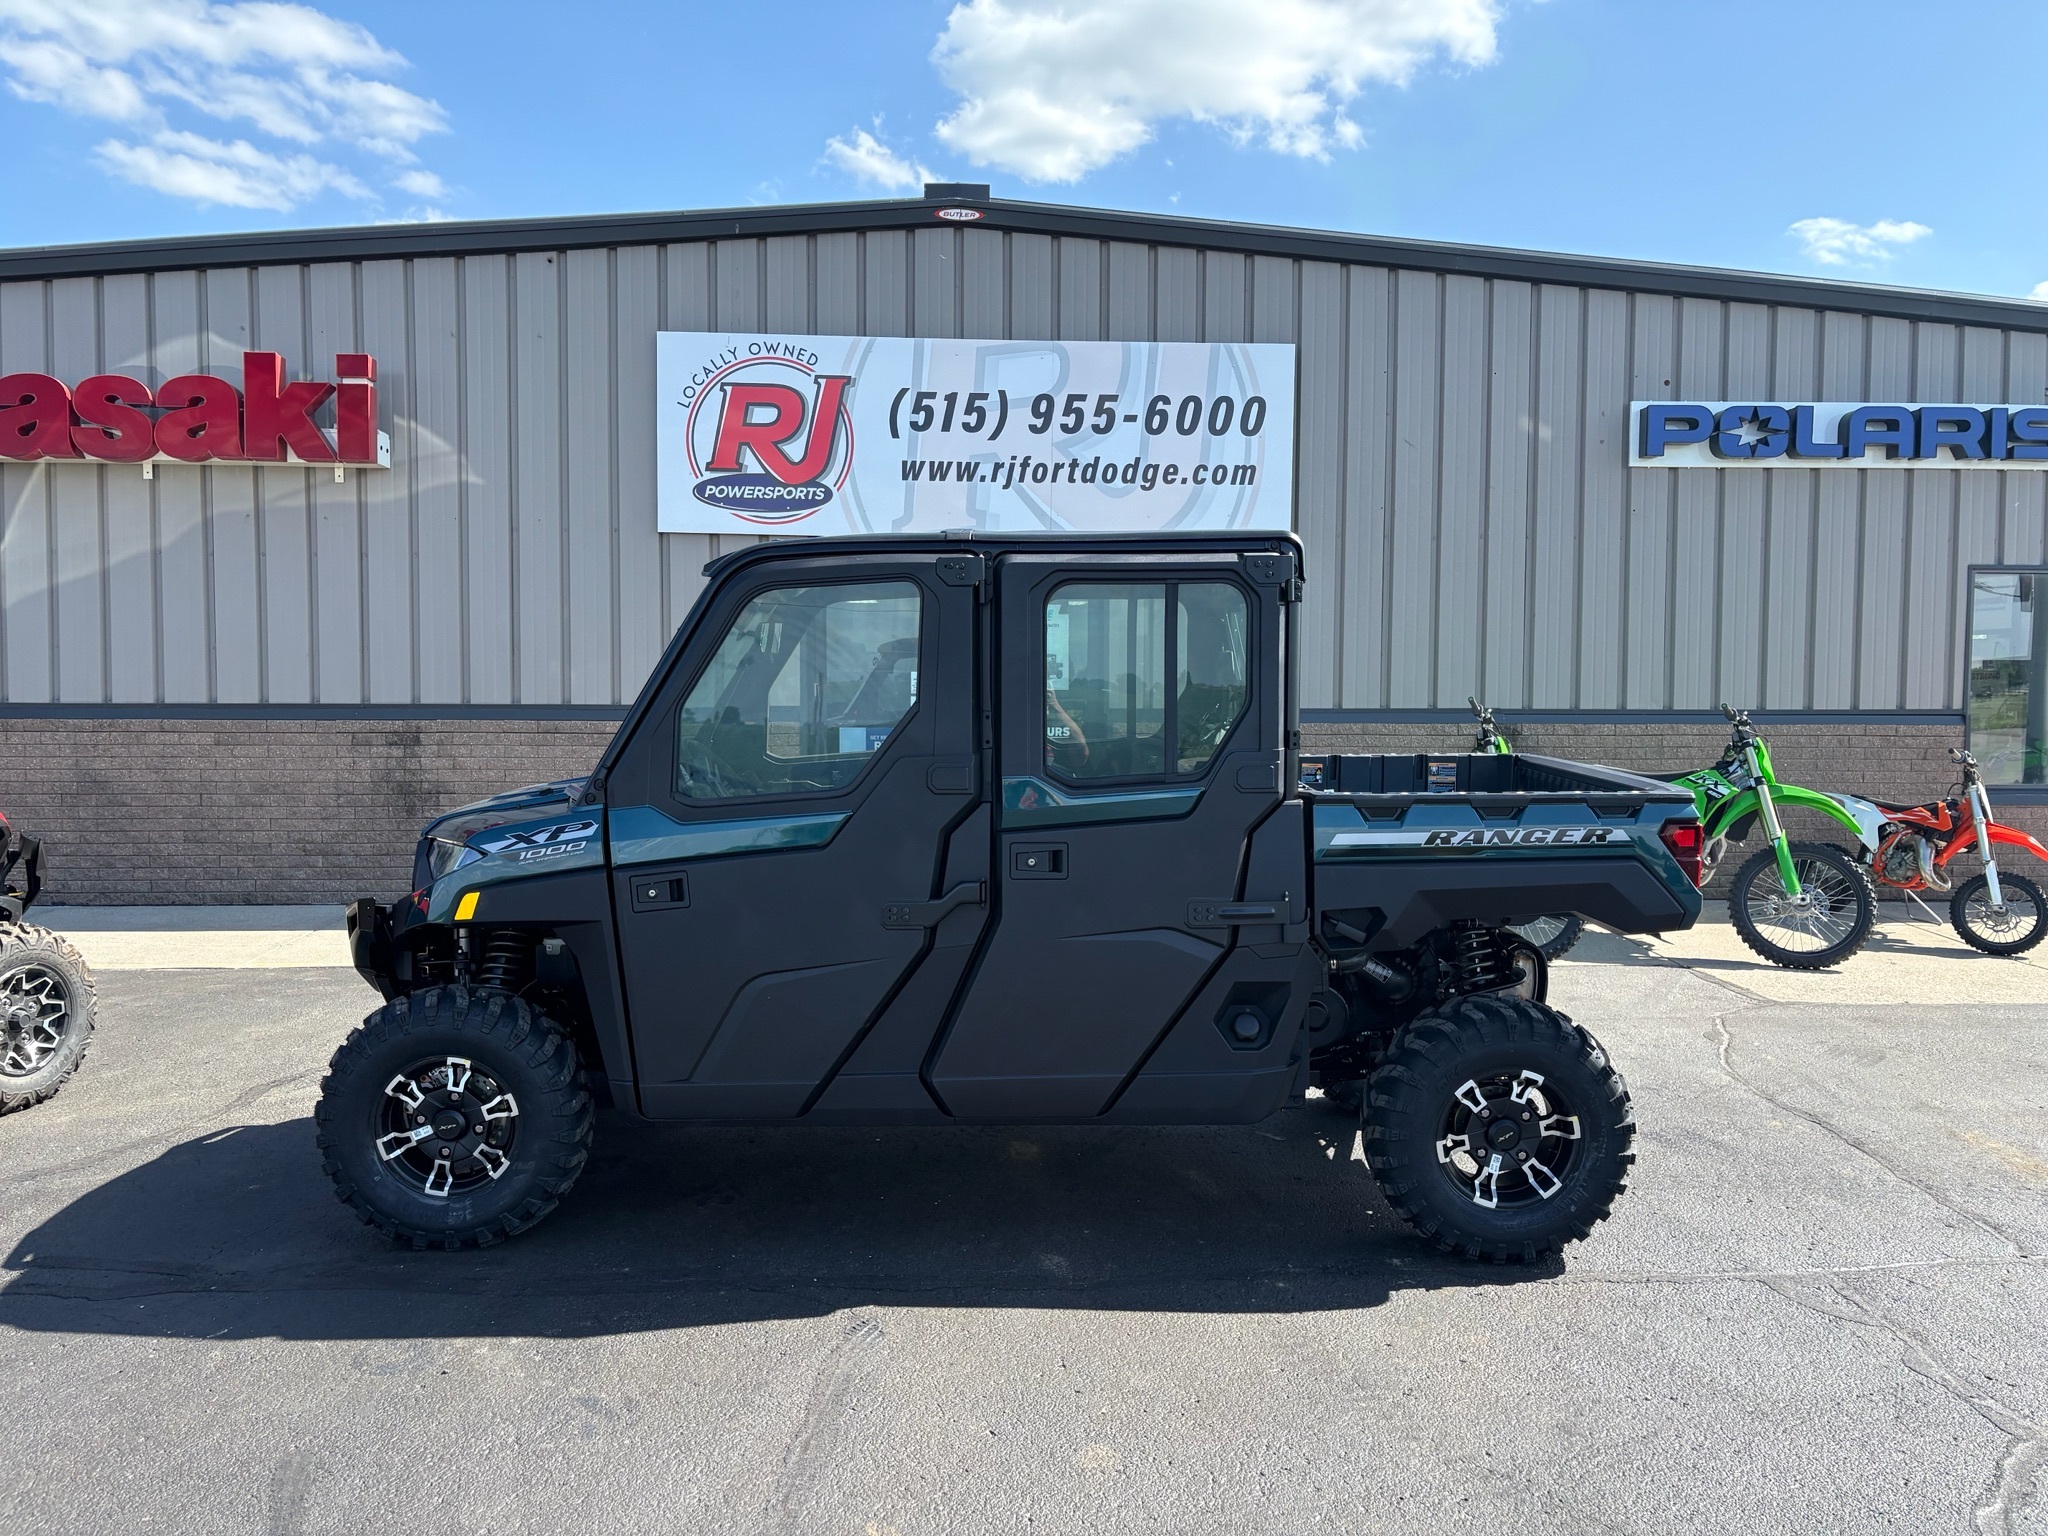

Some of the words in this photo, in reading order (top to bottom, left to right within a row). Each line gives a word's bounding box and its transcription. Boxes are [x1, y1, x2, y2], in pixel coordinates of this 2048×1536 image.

[677, 346, 738, 409] LOCALLY
[748, 341, 819, 366] OWNED
[0, 351, 378, 463] asaki
[889, 387, 1009, 441] (515)
[1028, 393, 1267, 437] 955-6000
[705, 375, 852, 485] RJ
[901, 455, 1257, 492] www.rjfortdodge.com
[704, 485, 826, 500] POWERSPORTS
[497, 820, 596, 852] XP
[518, 840, 589, 861] 1000
[1421, 827, 1614, 848] RANGER
